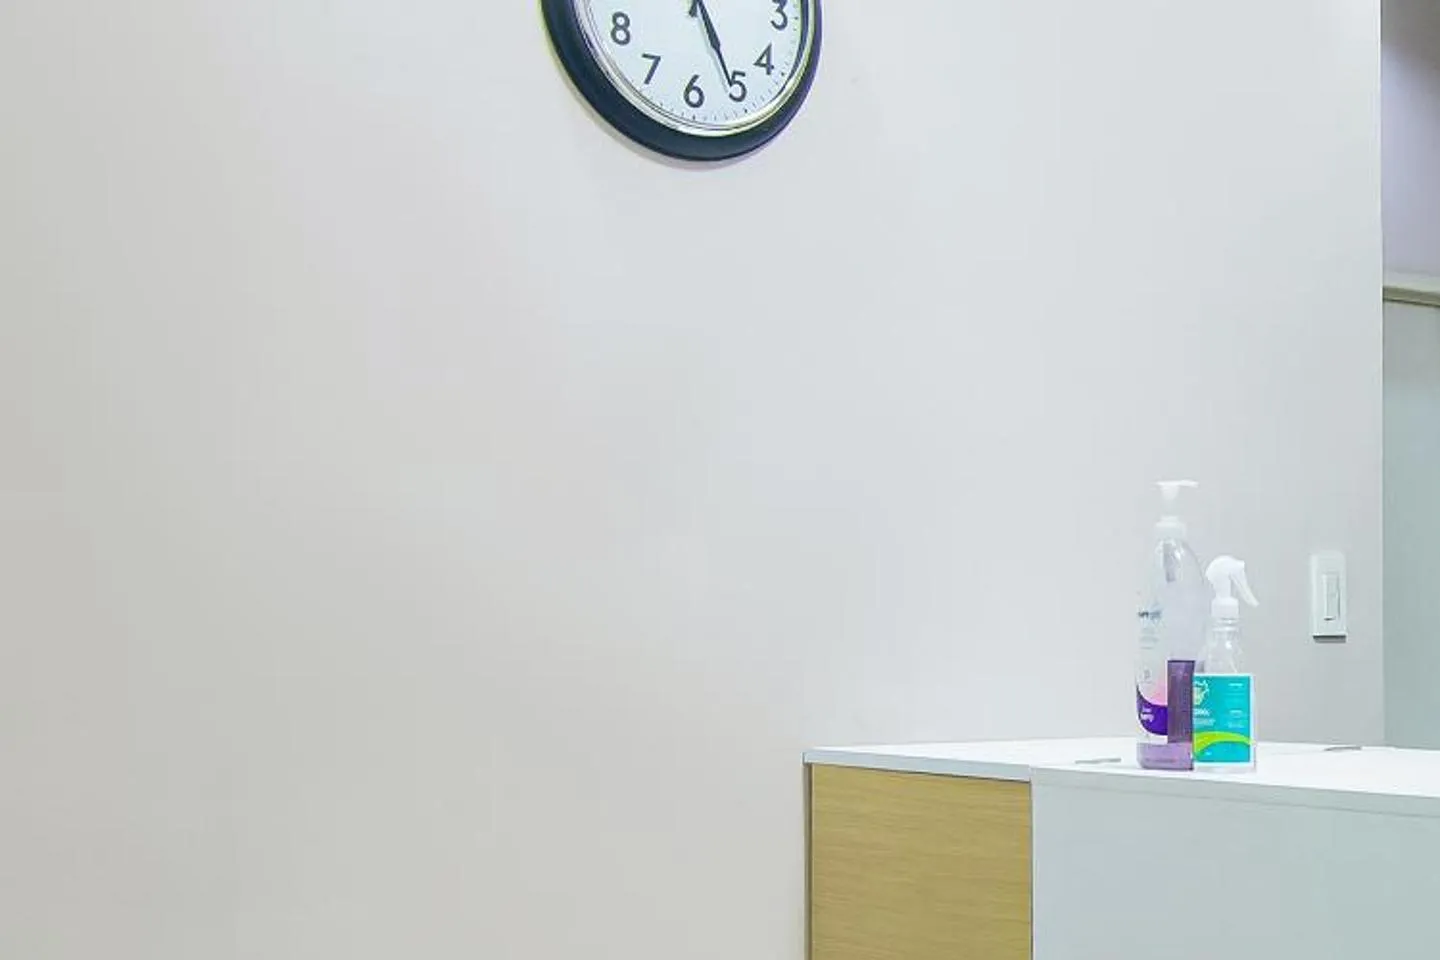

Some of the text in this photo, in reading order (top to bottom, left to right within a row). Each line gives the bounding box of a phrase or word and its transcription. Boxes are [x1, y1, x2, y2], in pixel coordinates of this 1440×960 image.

[611, 12, 631, 45] 8
[771, 0, 788, 30] 3
[642, 53, 661, 85] 7
[754, 44, 774, 75] 4
[683, 74, 705, 108] 6
[728, 71, 747, 102] 5
